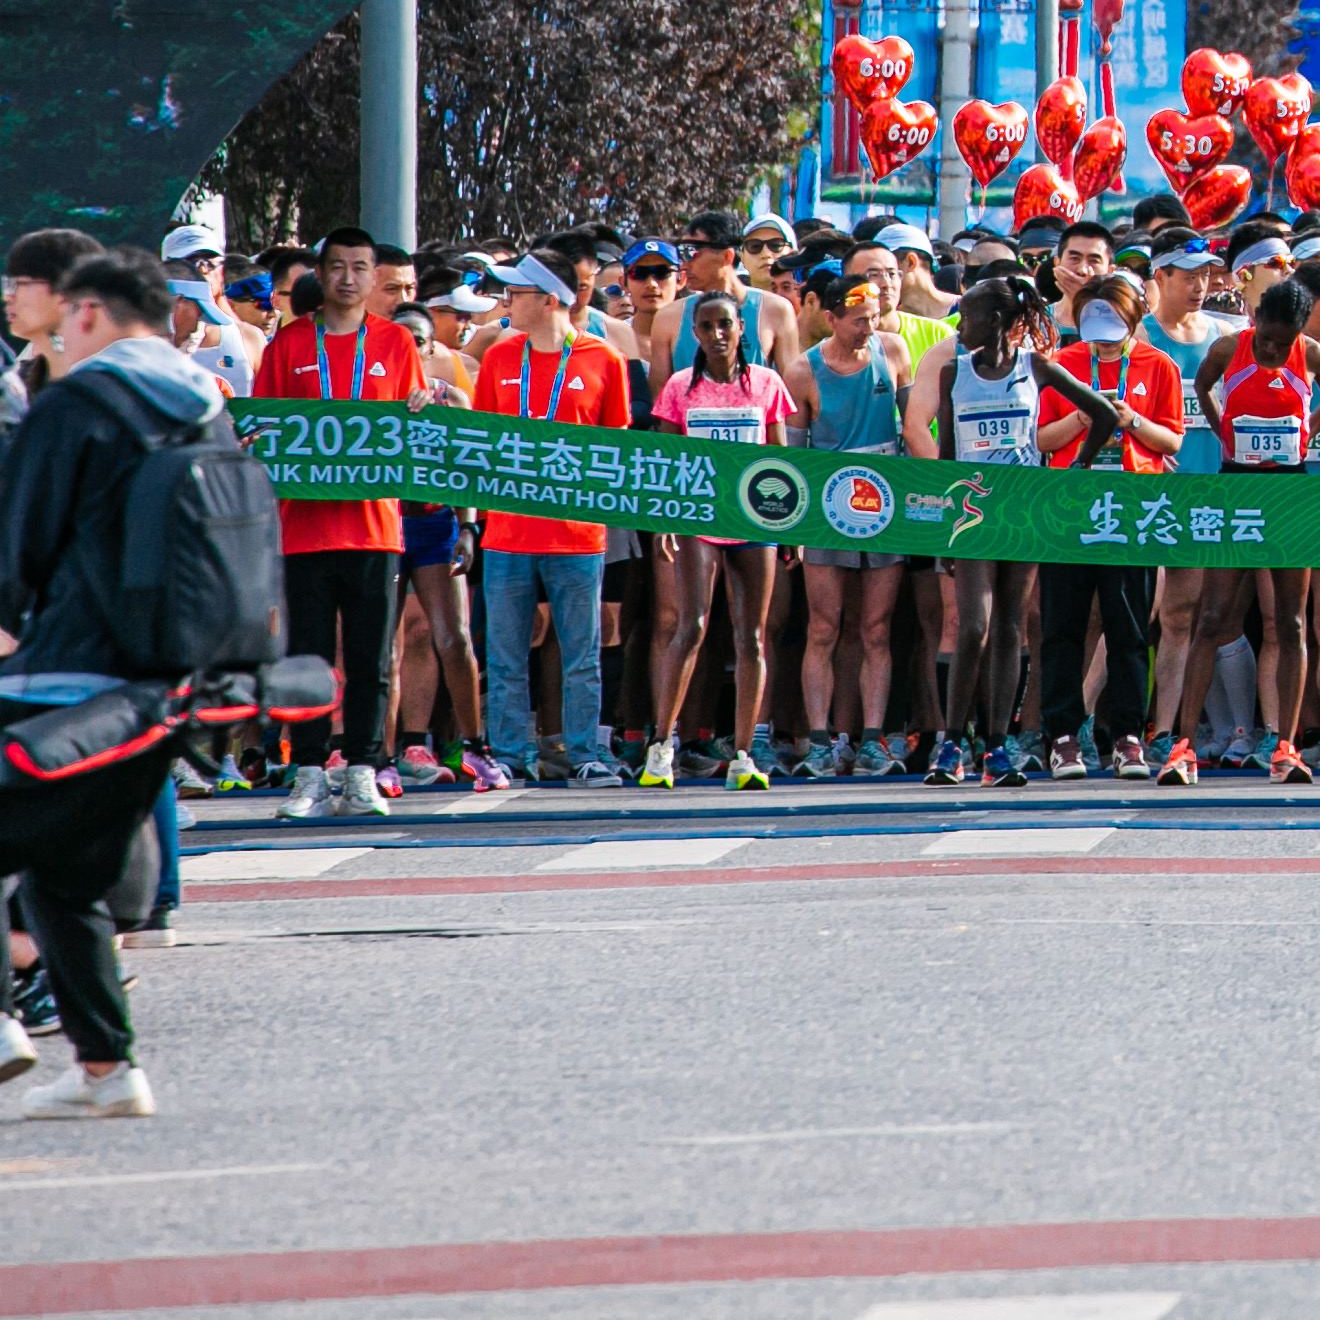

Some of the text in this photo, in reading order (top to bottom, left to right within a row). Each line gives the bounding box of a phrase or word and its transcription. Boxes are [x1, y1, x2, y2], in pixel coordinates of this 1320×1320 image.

[860, 57, 906, 78] 6:00
[887, 123, 930, 145] 6:00
[986, 122, 1025, 142] 6:00
[1161, 131, 1212, 155] 5:30
[1050, 190, 1084, 223] 6:00
[978, 419, 1010, 437] 039
[1251, 435, 1282, 451] 035
[310, 465, 404, 484] MIYUN
[413, 467, 469, 491] ECO
[476, 474, 640, 515] MARATHON
[646, 497, 717, 523] 2023
[905, 493, 956, 510] CHINA
[1079, 491, 1266, 547] 生态密云
